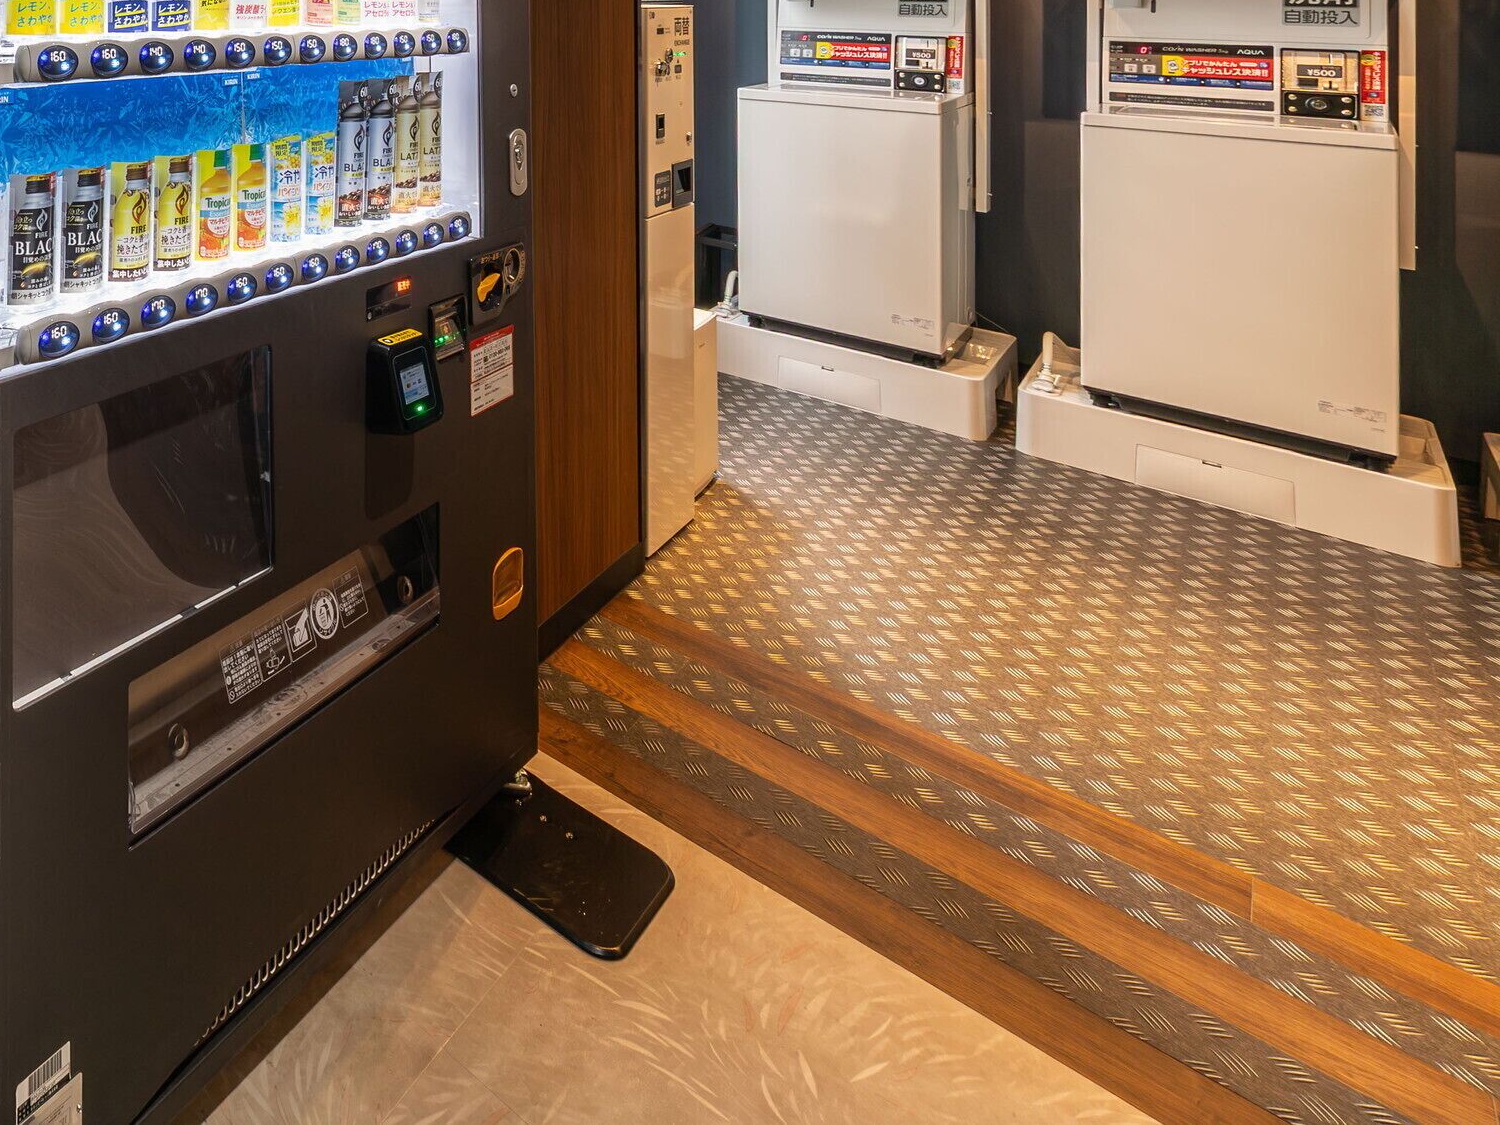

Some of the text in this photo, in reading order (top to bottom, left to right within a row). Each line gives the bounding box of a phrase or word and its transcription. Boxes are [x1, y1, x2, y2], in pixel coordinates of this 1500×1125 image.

[900, 3, 947, 17] 自動投入
[1284, 9, 1358, 25] 自動投入
[50, 51, 66, 62] 160
[102, 48, 117, 58] 160
[150, 46, 163, 56] 140
[193, 45, 205, 54] 140
[233, 43, 246, 52] 150
[271, 41, 283, 50] 150
[306, 39, 318, 48] 150
[1307, 68, 1336, 78] ¥500
[174, 216, 189, 225] FIRE
[131, 224, 146, 234] FIRE
[51, 326, 67, 338] 160
[103, 312, 118, 324] 160
[151, 300, 165, 311] 170
[195, 288, 208, 298] 170
